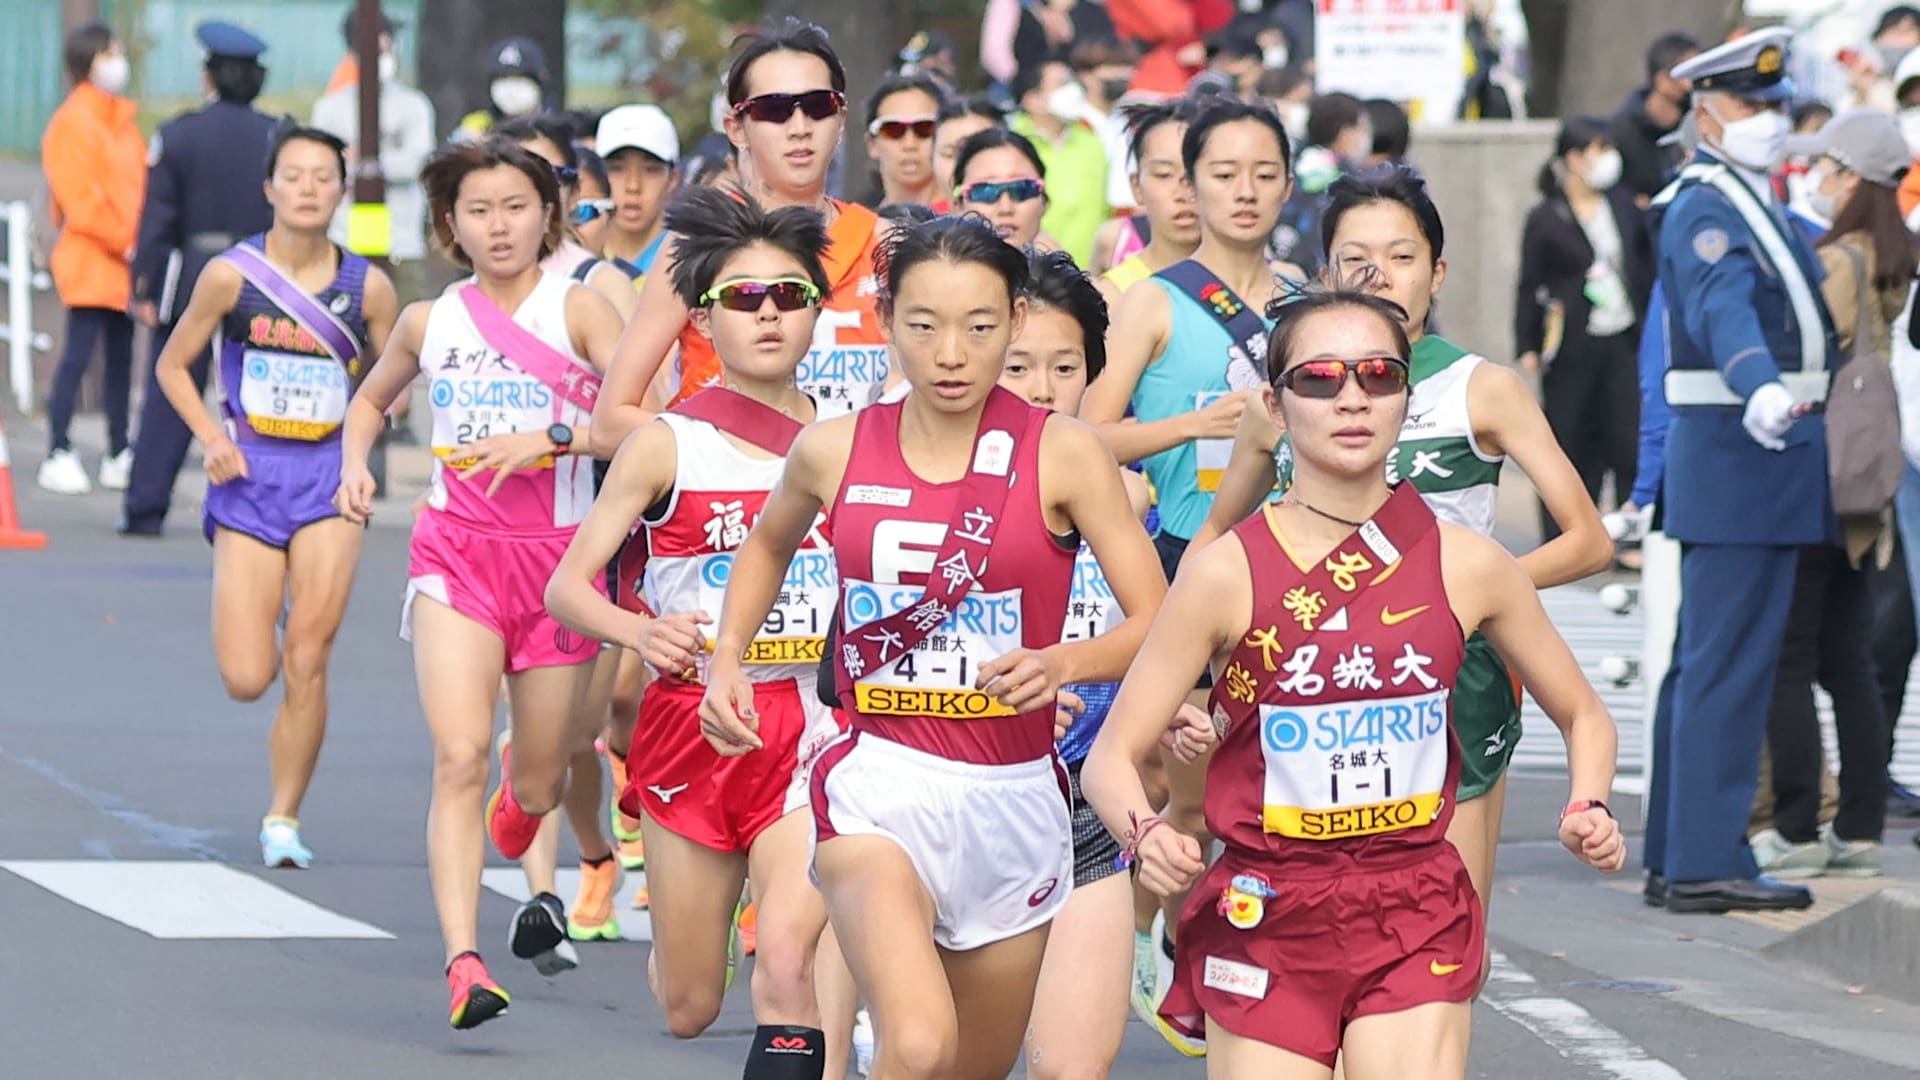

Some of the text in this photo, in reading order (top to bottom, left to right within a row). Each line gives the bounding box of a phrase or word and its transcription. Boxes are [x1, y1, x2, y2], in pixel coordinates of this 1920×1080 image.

[457, 380, 550, 408] STARTS
[466, 411, 507, 423] 玉川大
[775, 591, 811, 606] 岡大
[1066, 600, 1103, 619] 育大
[914, 634, 968, 653] 命館大
[893, 651, 967, 686] 4-1
[1276, 643, 1439, 697] 名城大
[868, 687, 990, 714] SEIKO
[1314, 697, 1443, 751] STARTS
[1329, 748, 1389, 771] 名城大
[1331, 767, 1391, 804] 1-1
[1301, 800, 1418, 836] SEIKO
